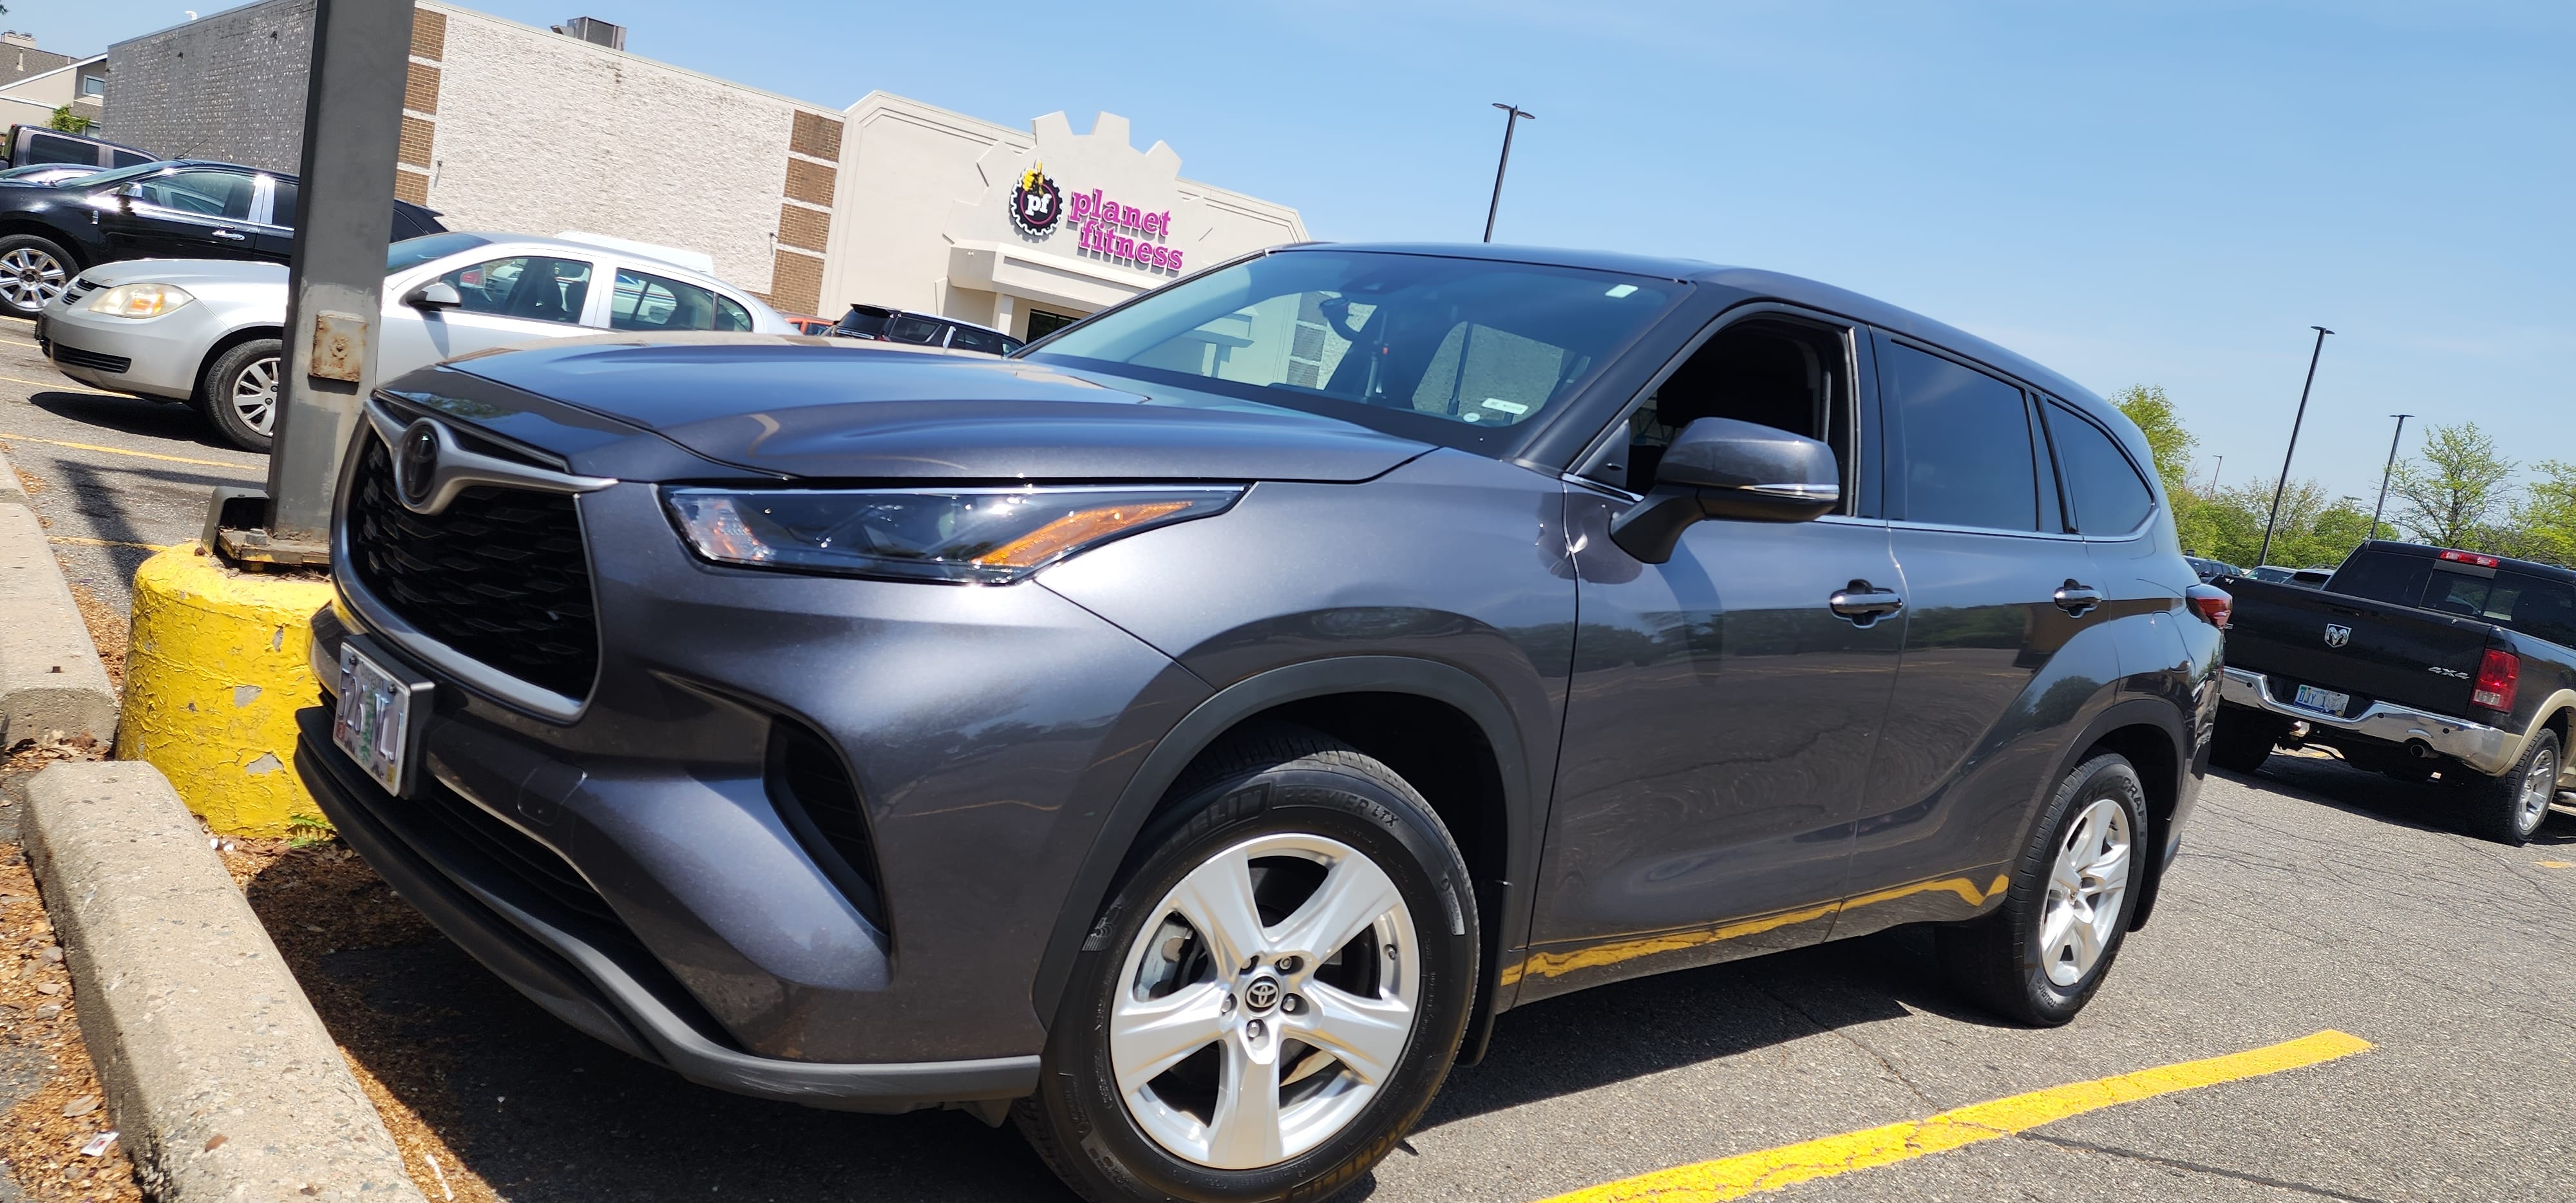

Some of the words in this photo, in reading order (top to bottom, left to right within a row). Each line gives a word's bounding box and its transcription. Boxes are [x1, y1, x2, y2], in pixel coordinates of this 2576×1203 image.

[1027, 193, 1052, 216] pf
[1069, 188, 1171, 236] planet
[1079, 220, 1184, 271] fitness
[1284, 786, 1370, 815] PREMIER
[1372, 804, 1400, 828] LTX
